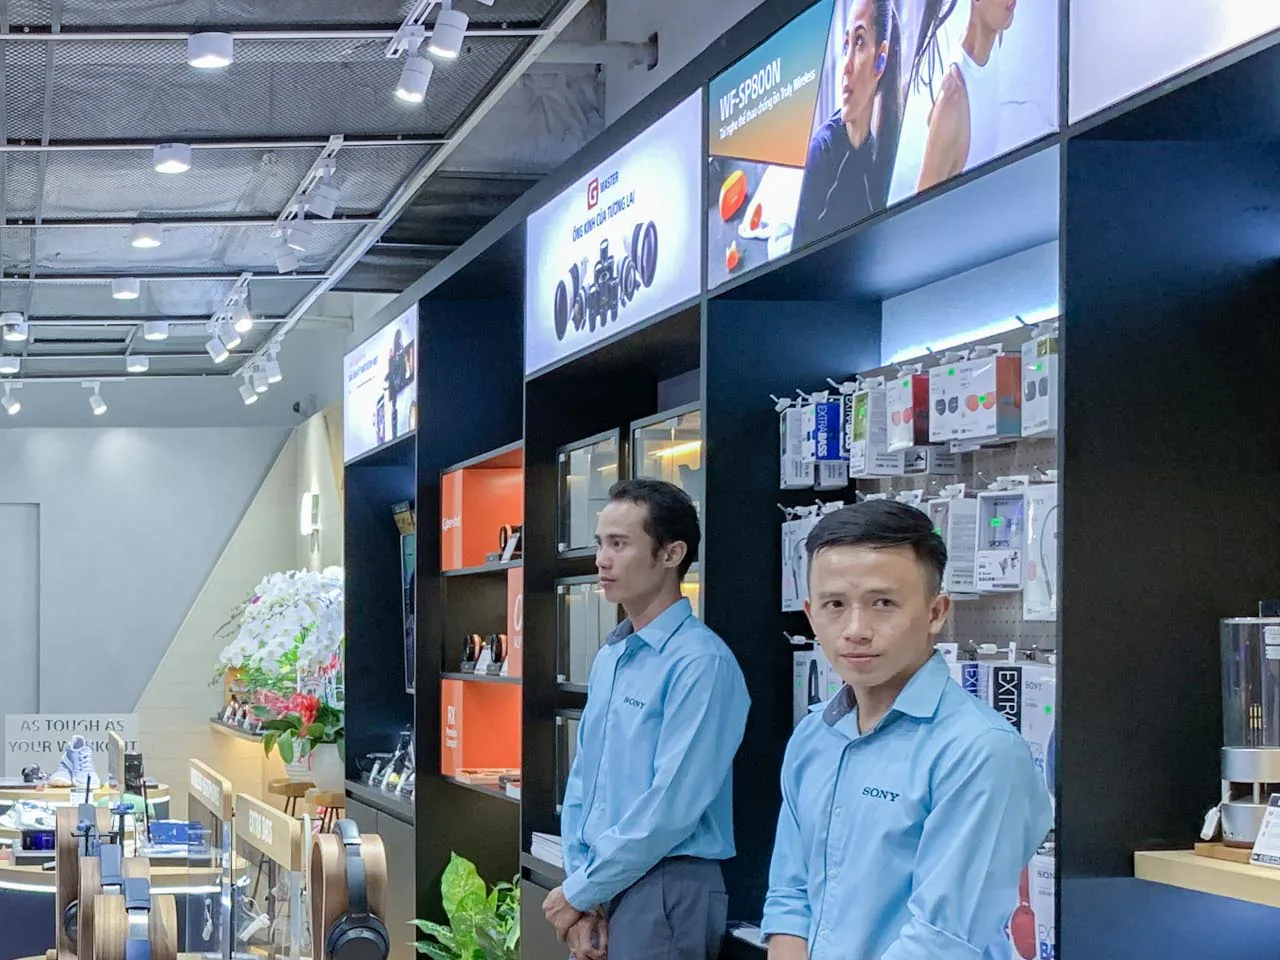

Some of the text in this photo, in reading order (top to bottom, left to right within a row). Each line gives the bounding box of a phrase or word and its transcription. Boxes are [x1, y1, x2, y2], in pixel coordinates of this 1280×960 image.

[719, 57, 781, 121] WF-SP800N
[623, 696, 646, 709] SONY
[20, 719, 126, 732] AS TOUGH AS
[8, 740, 52, 753] YOUR
[862, 786, 900, 802] SONY
